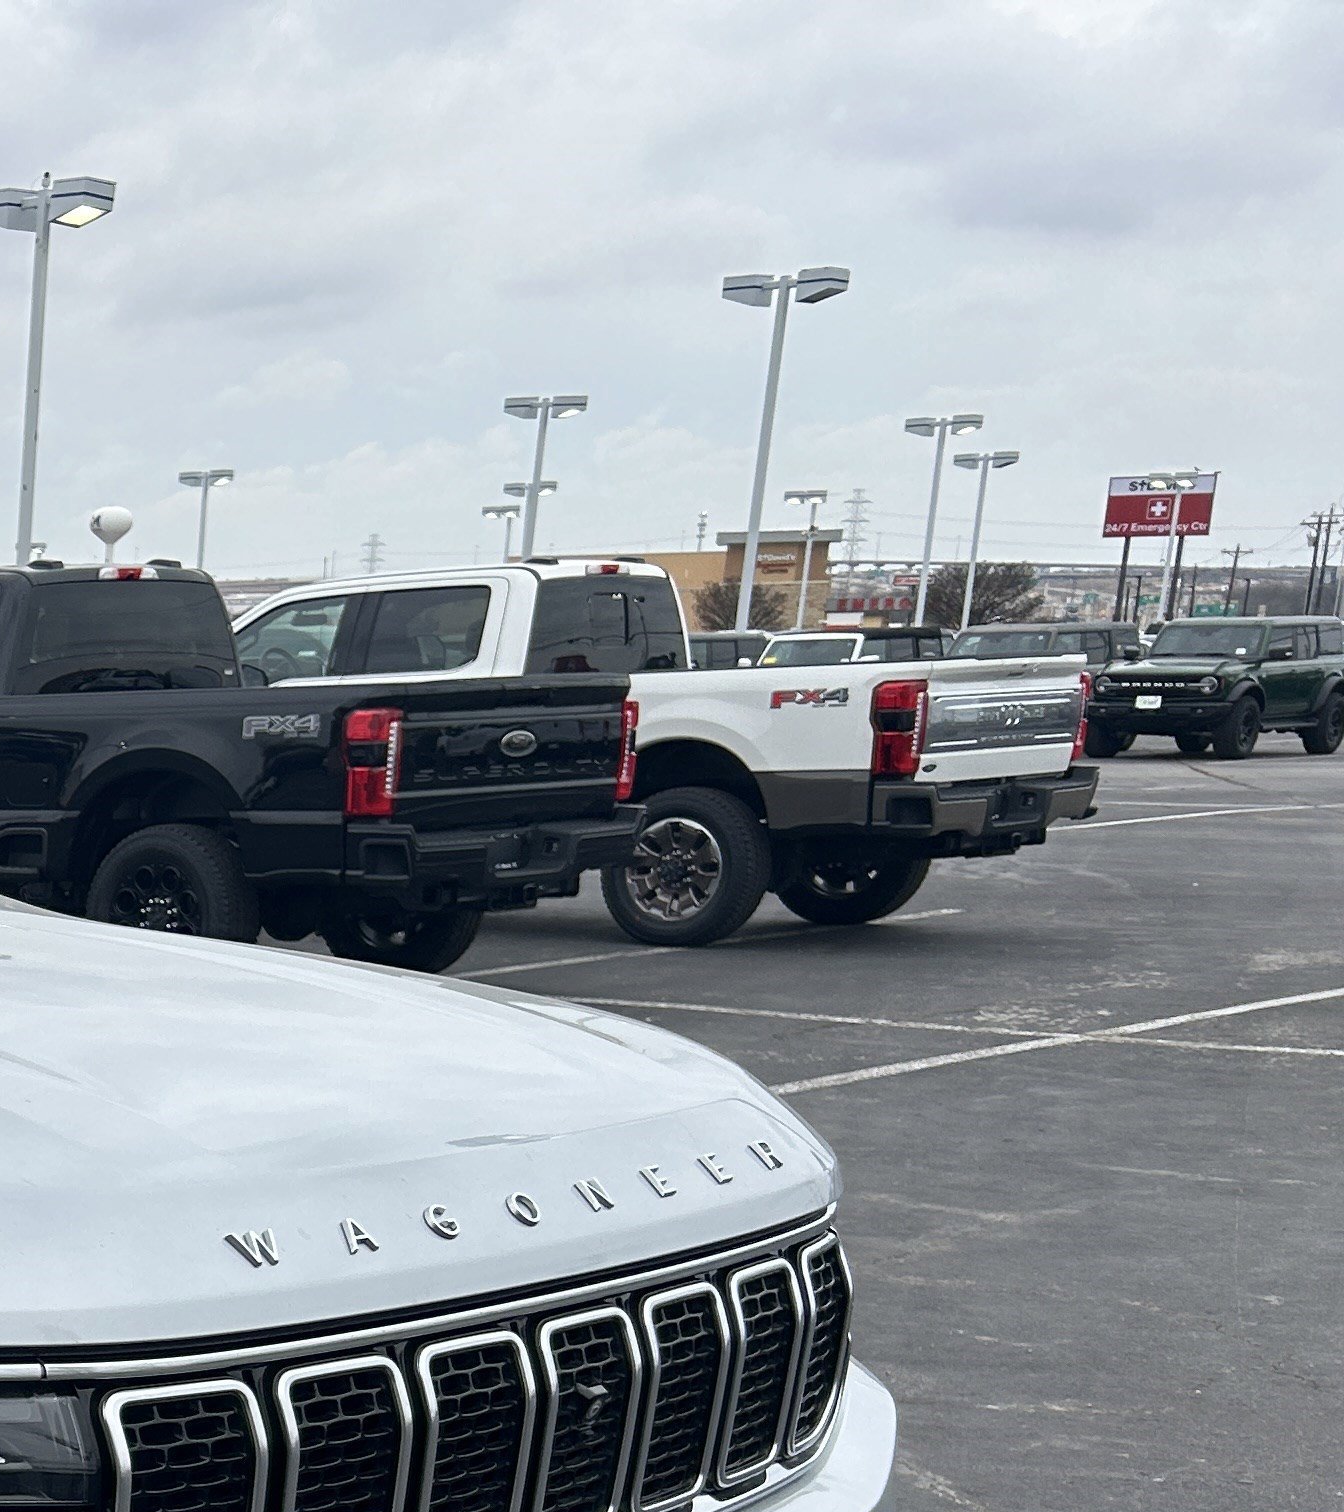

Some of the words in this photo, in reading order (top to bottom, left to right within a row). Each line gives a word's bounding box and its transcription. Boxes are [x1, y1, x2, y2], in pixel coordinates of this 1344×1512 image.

[1105, 523, 1129, 533] 24/7
[1131, 522, 1190, 533] Emergecy
[1191, 521, 1208, 531] Ctr
[770, 687, 849, 709] FX4
[242, 713, 320, 740] FX4
[224, 1139, 784, 1268] WAGONEER
